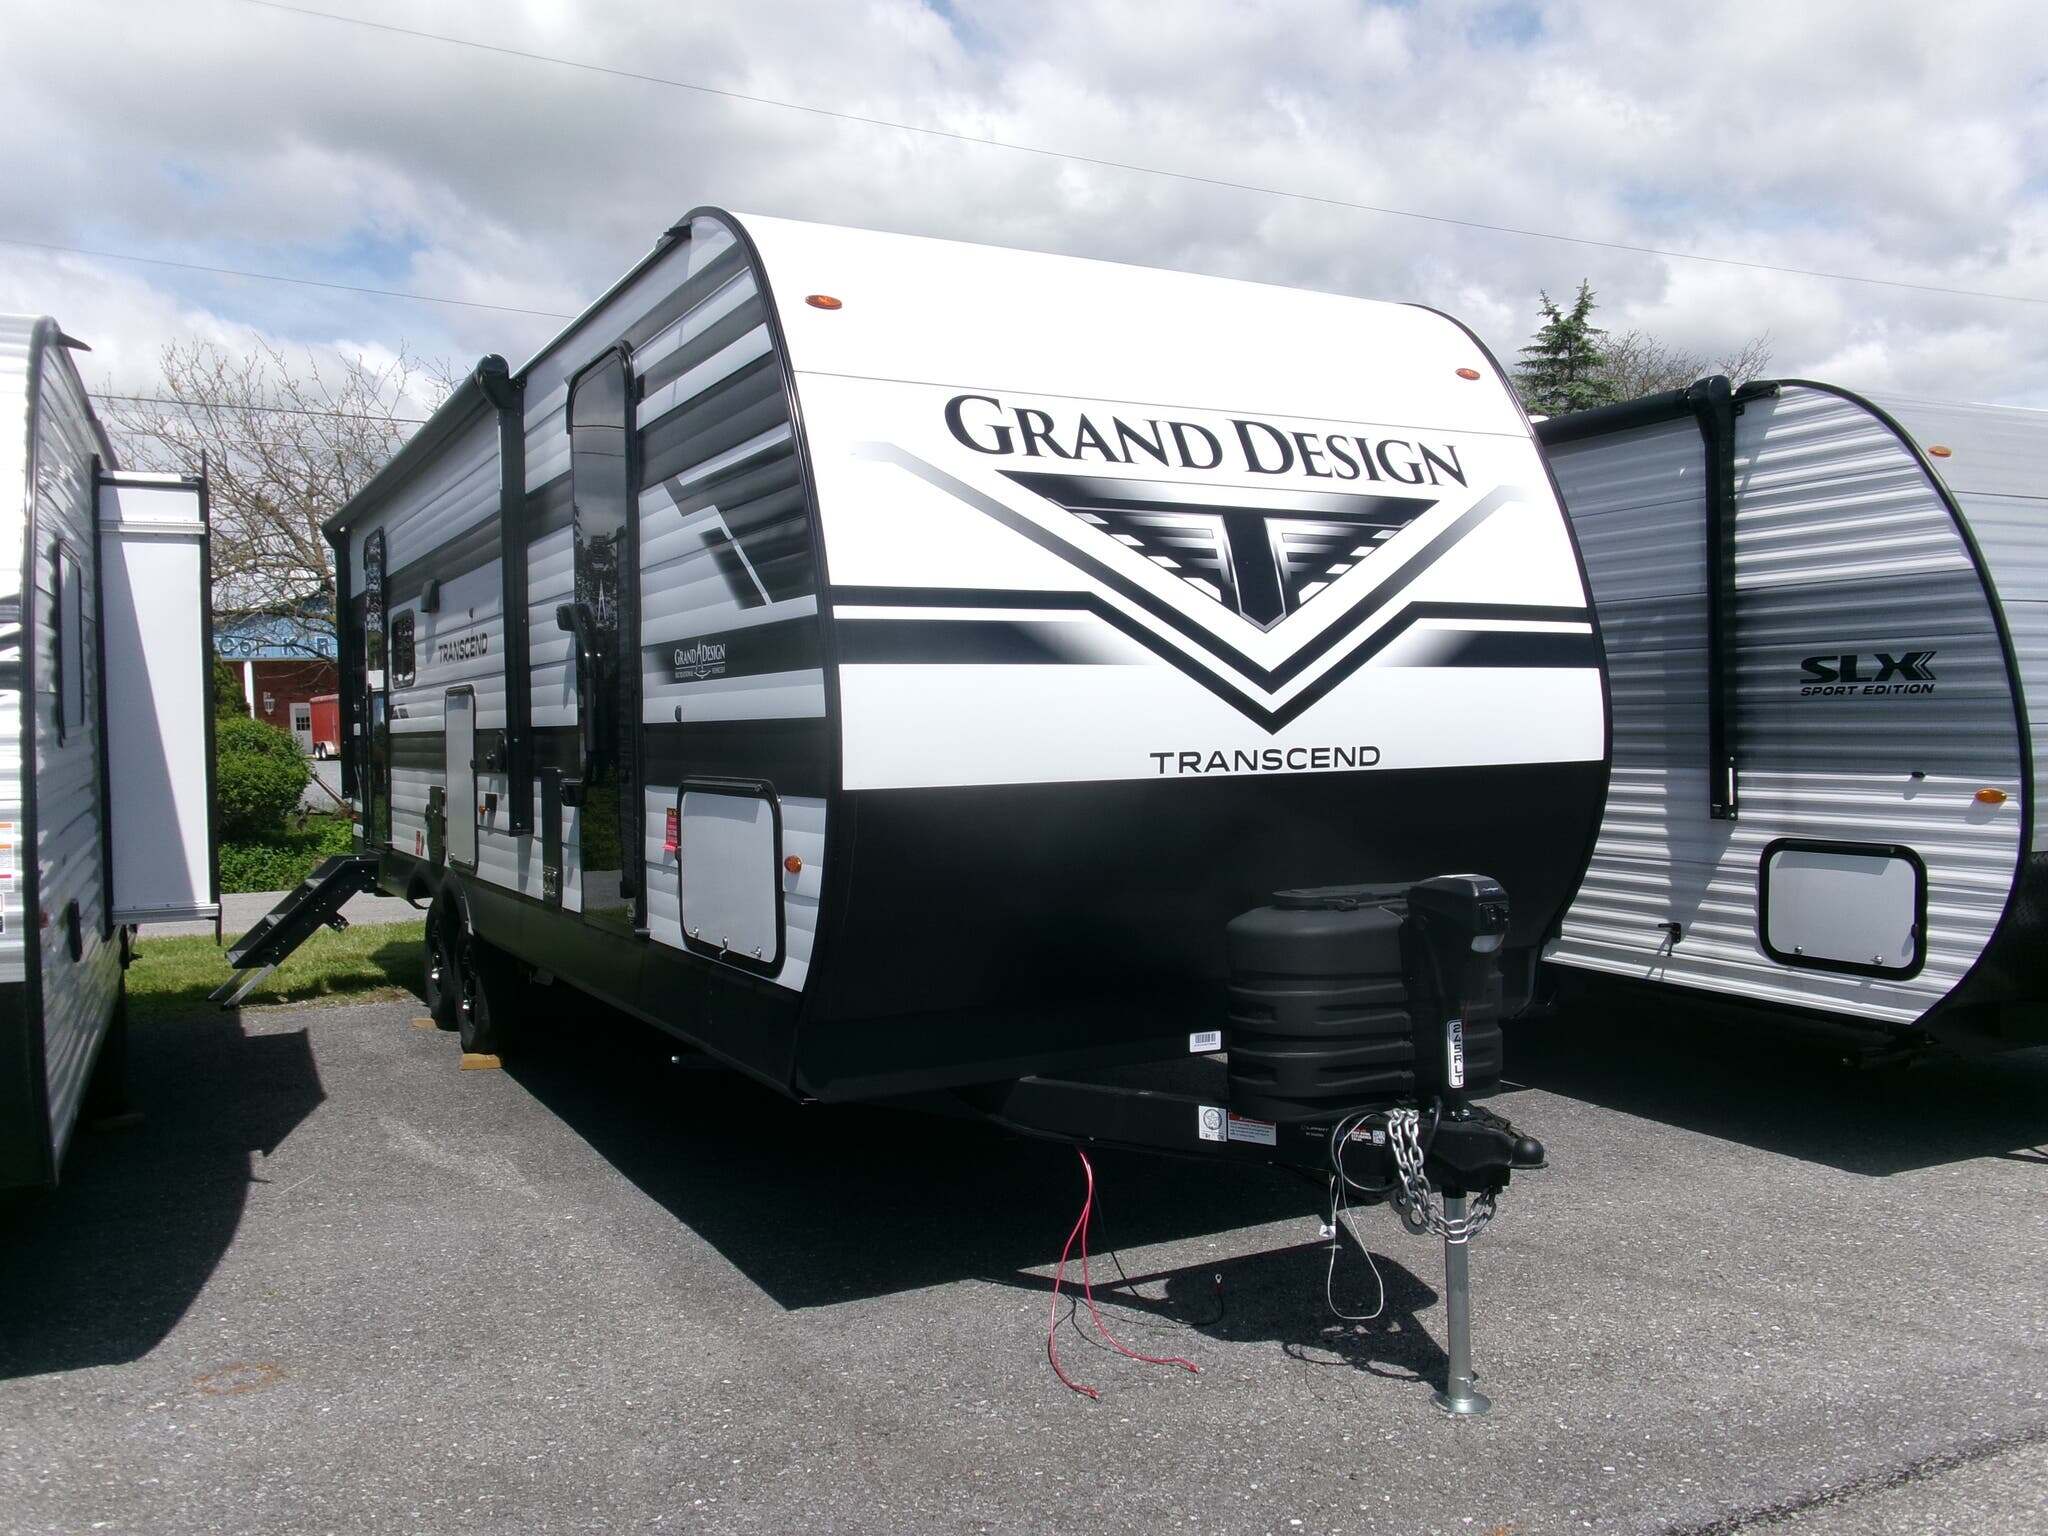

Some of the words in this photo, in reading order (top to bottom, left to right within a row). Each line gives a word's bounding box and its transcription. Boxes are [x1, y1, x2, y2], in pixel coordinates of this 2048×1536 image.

[944, 394, 1224, 469] GRAND
[1227, 418, 1469, 488] DESIGN
[438, 631, 488, 664] TRANSCEND
[674, 648, 697, 666] GRAND
[702, 643, 726, 661] DESIGN
[1800, 651, 1937, 684] SLX
[1800, 685, 1858, 697] SPORT
[1862, 684, 1935, 696] EDITION
[1149, 745, 1382, 775] TRANSCEND
